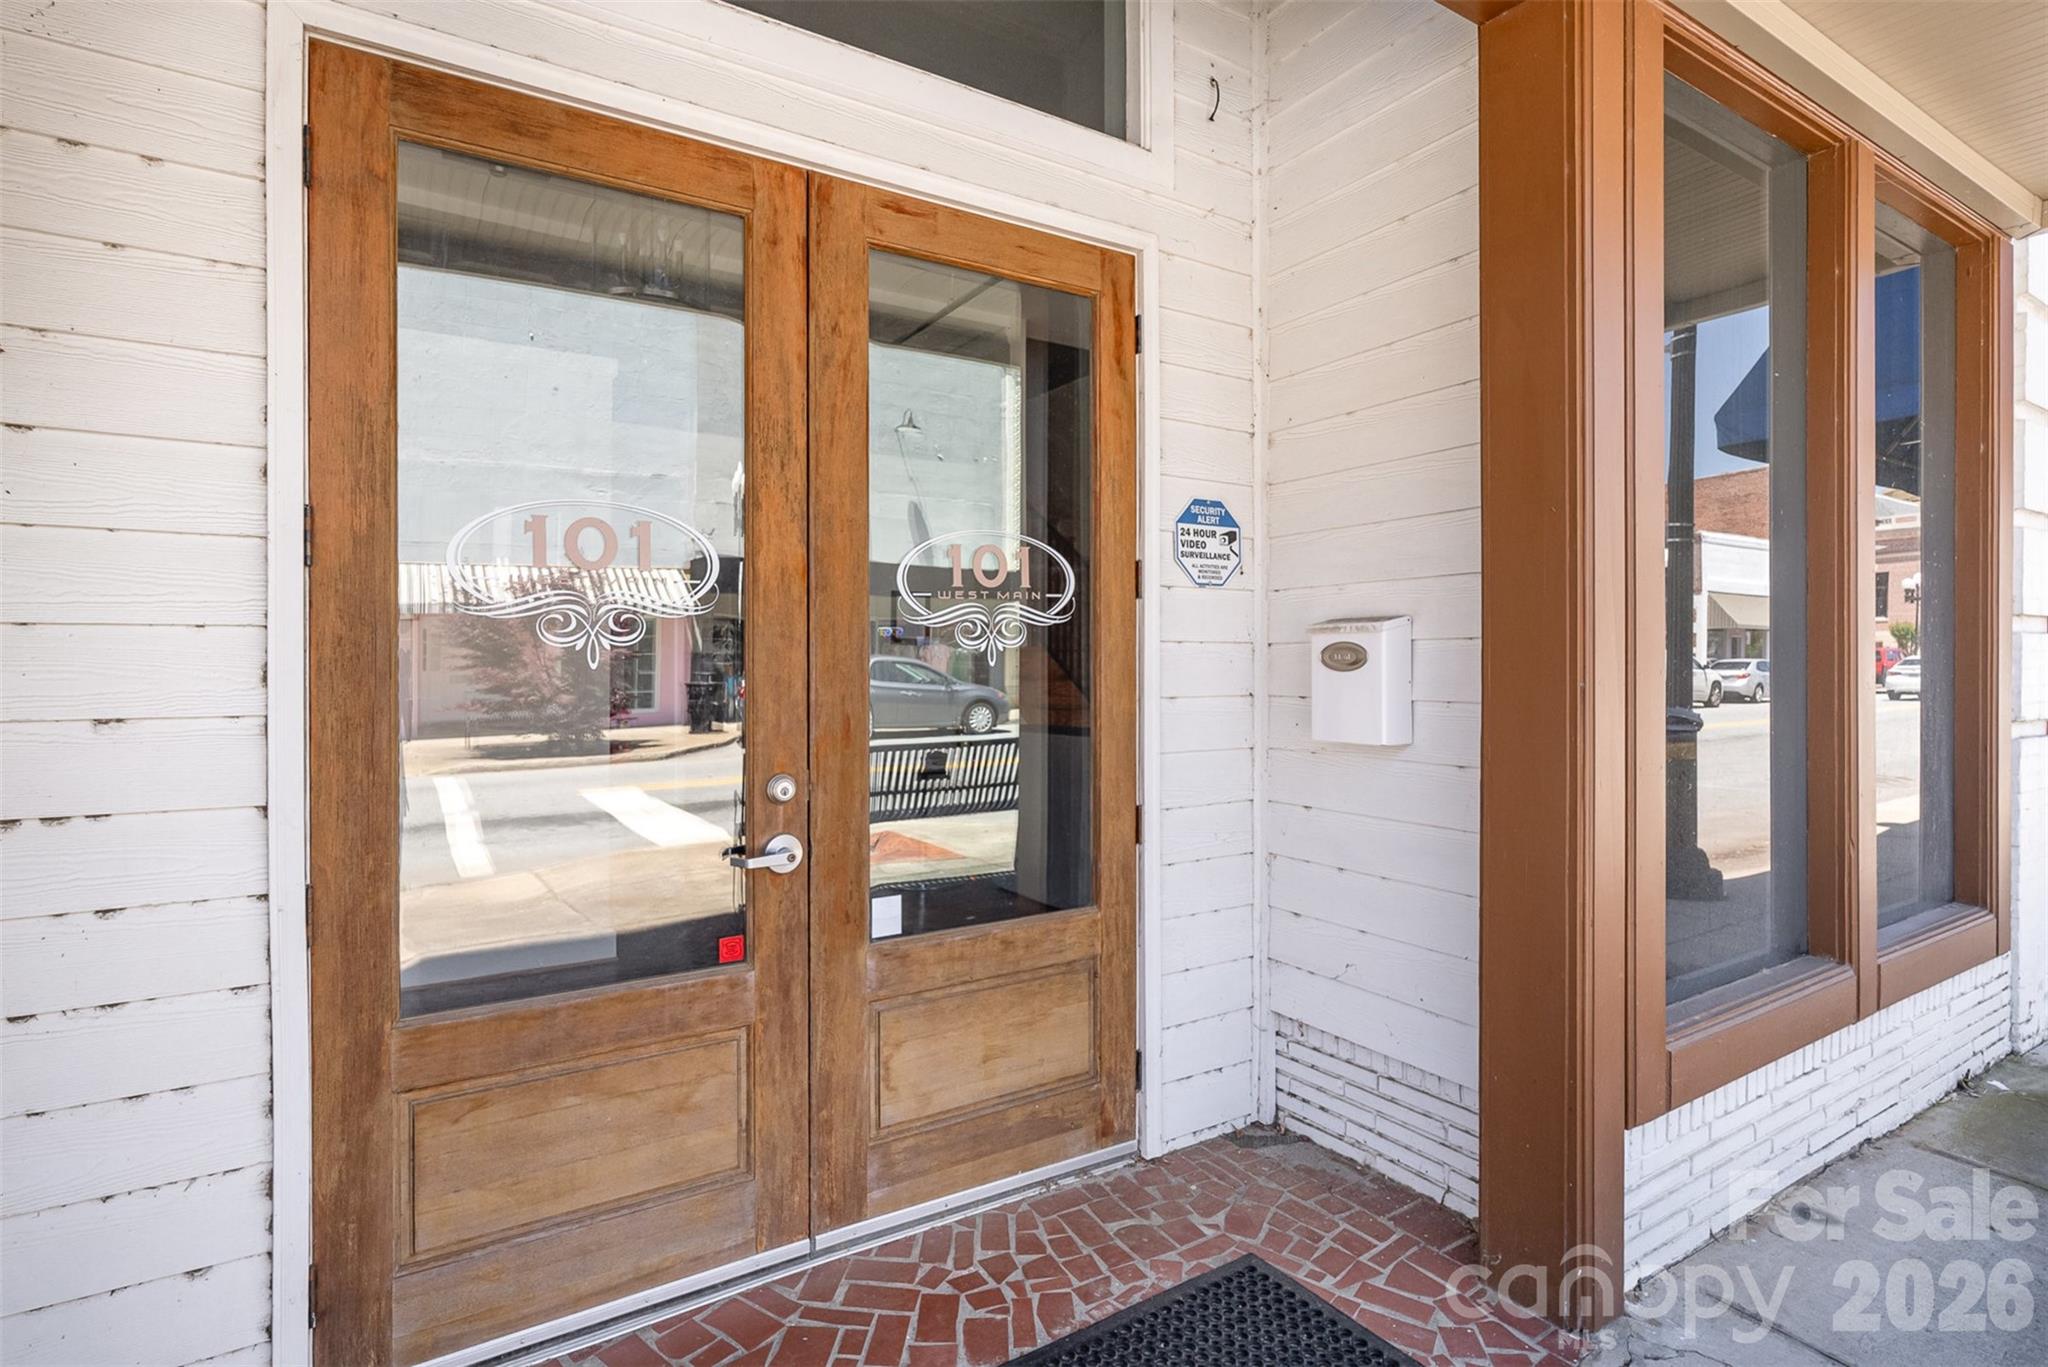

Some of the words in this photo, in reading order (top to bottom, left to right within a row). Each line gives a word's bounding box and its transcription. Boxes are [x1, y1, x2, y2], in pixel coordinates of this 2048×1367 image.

[1190, 505, 1226, 516] SECURITY
[1196, 516, 1220, 524] ALERT
[1180, 527, 1191, 536] 24
[1193, 528, 1217, 538] HOUR
[523, 514, 654, 572] 101
[1180, 540, 1206, 549] VIDEO
[1180, 551, 1231, 561] SURVEILLANCE
[946, 543, 1031, 589] 101
[937, 590, 990, 600] WEST
[996, 591, 1041, 600] MAIN
